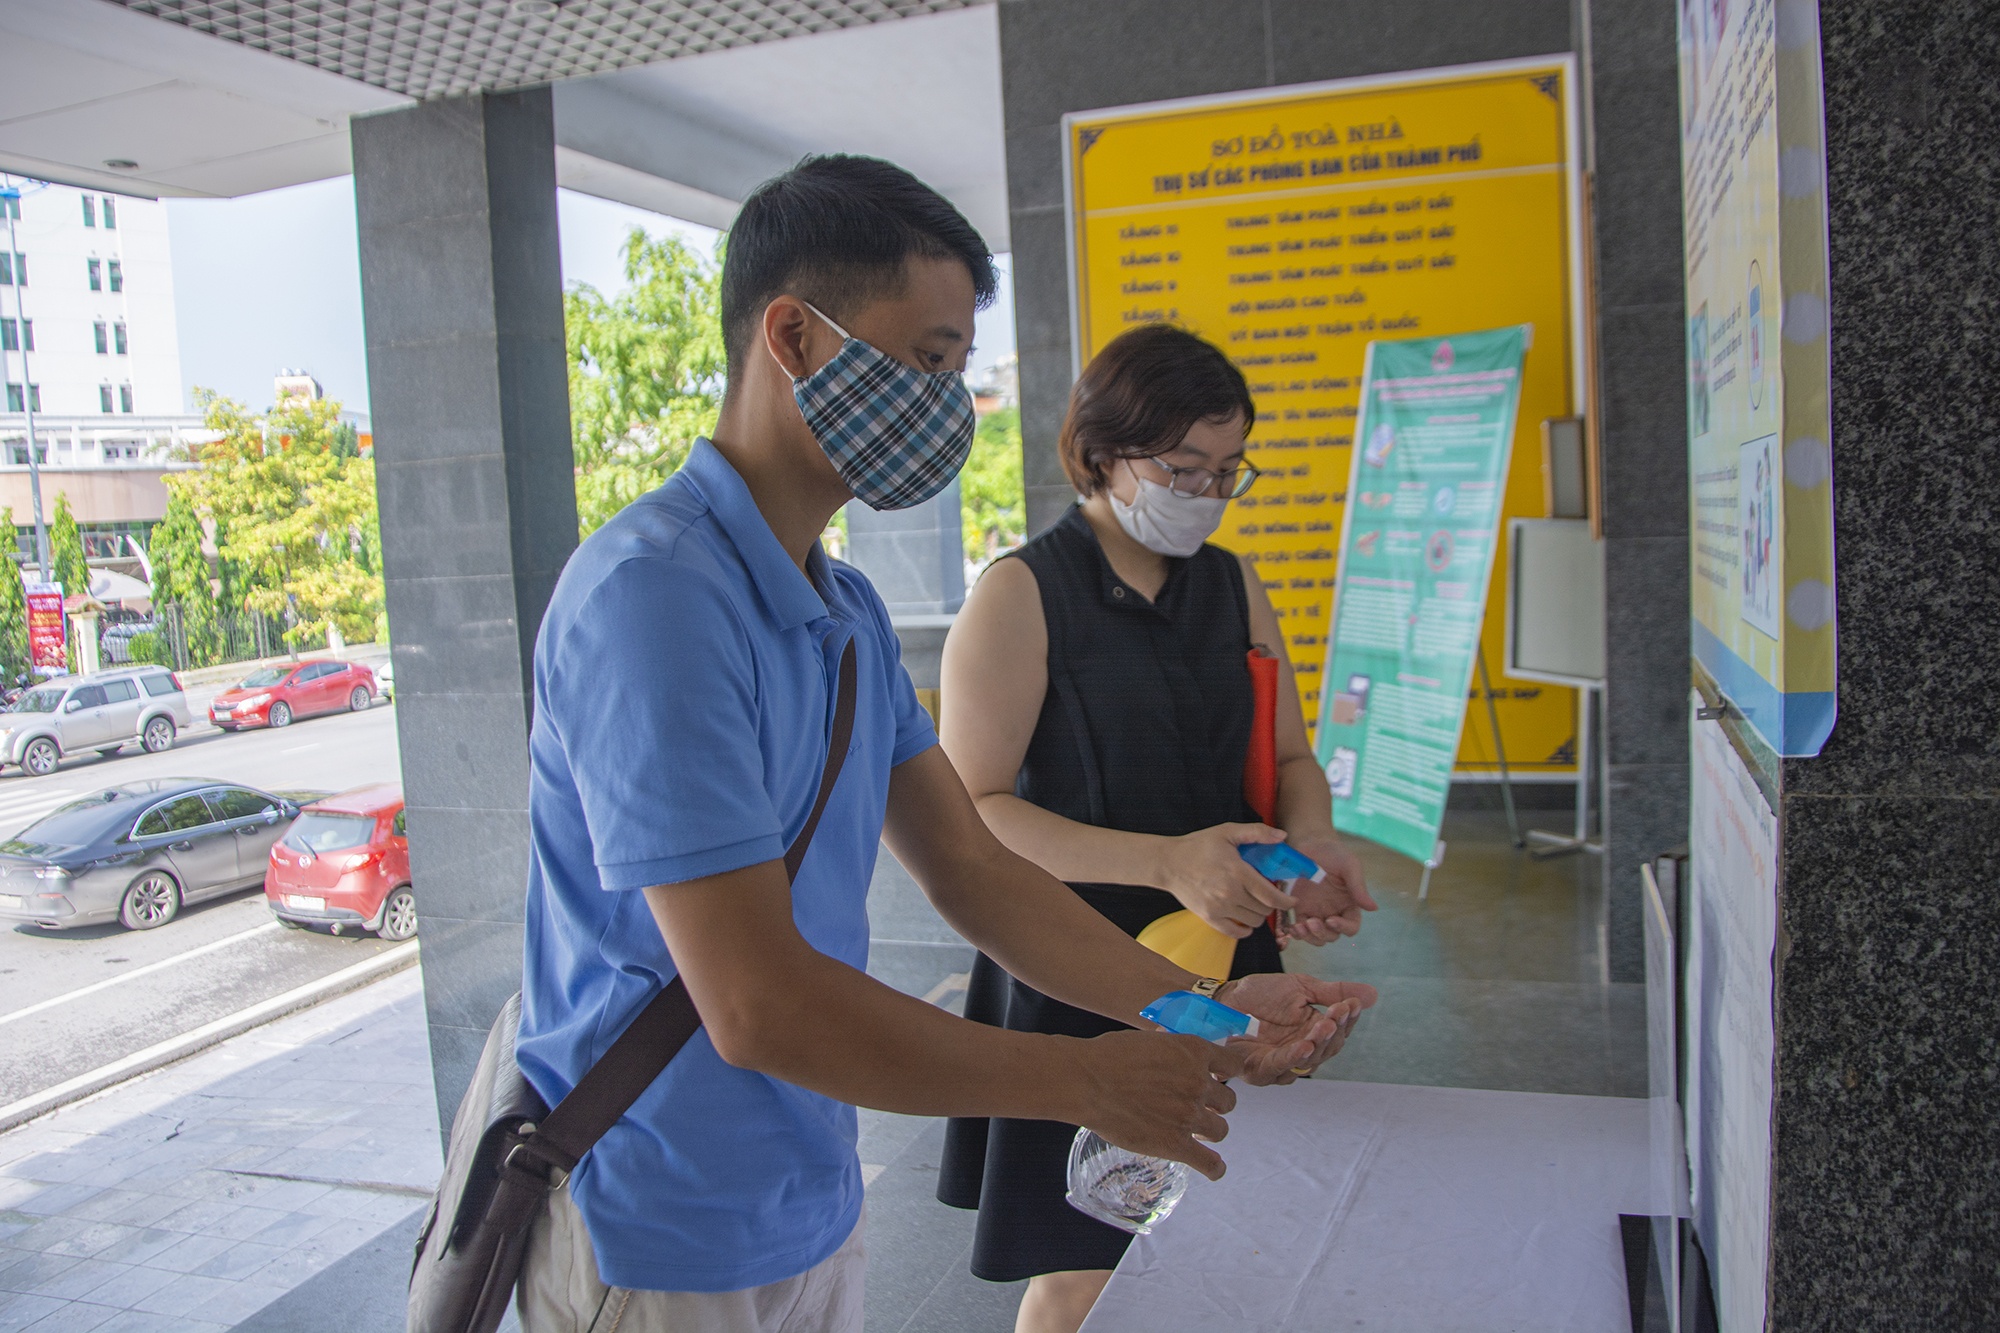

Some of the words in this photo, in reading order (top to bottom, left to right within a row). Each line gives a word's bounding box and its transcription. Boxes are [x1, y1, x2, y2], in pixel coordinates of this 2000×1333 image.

[1250, 158, 1304, 183] PHÒNG
[1310, 158, 1343, 176] BAN
[1349, 145, 1381, 171] CỦA
[1386, 145, 1442, 168] THÀNH
